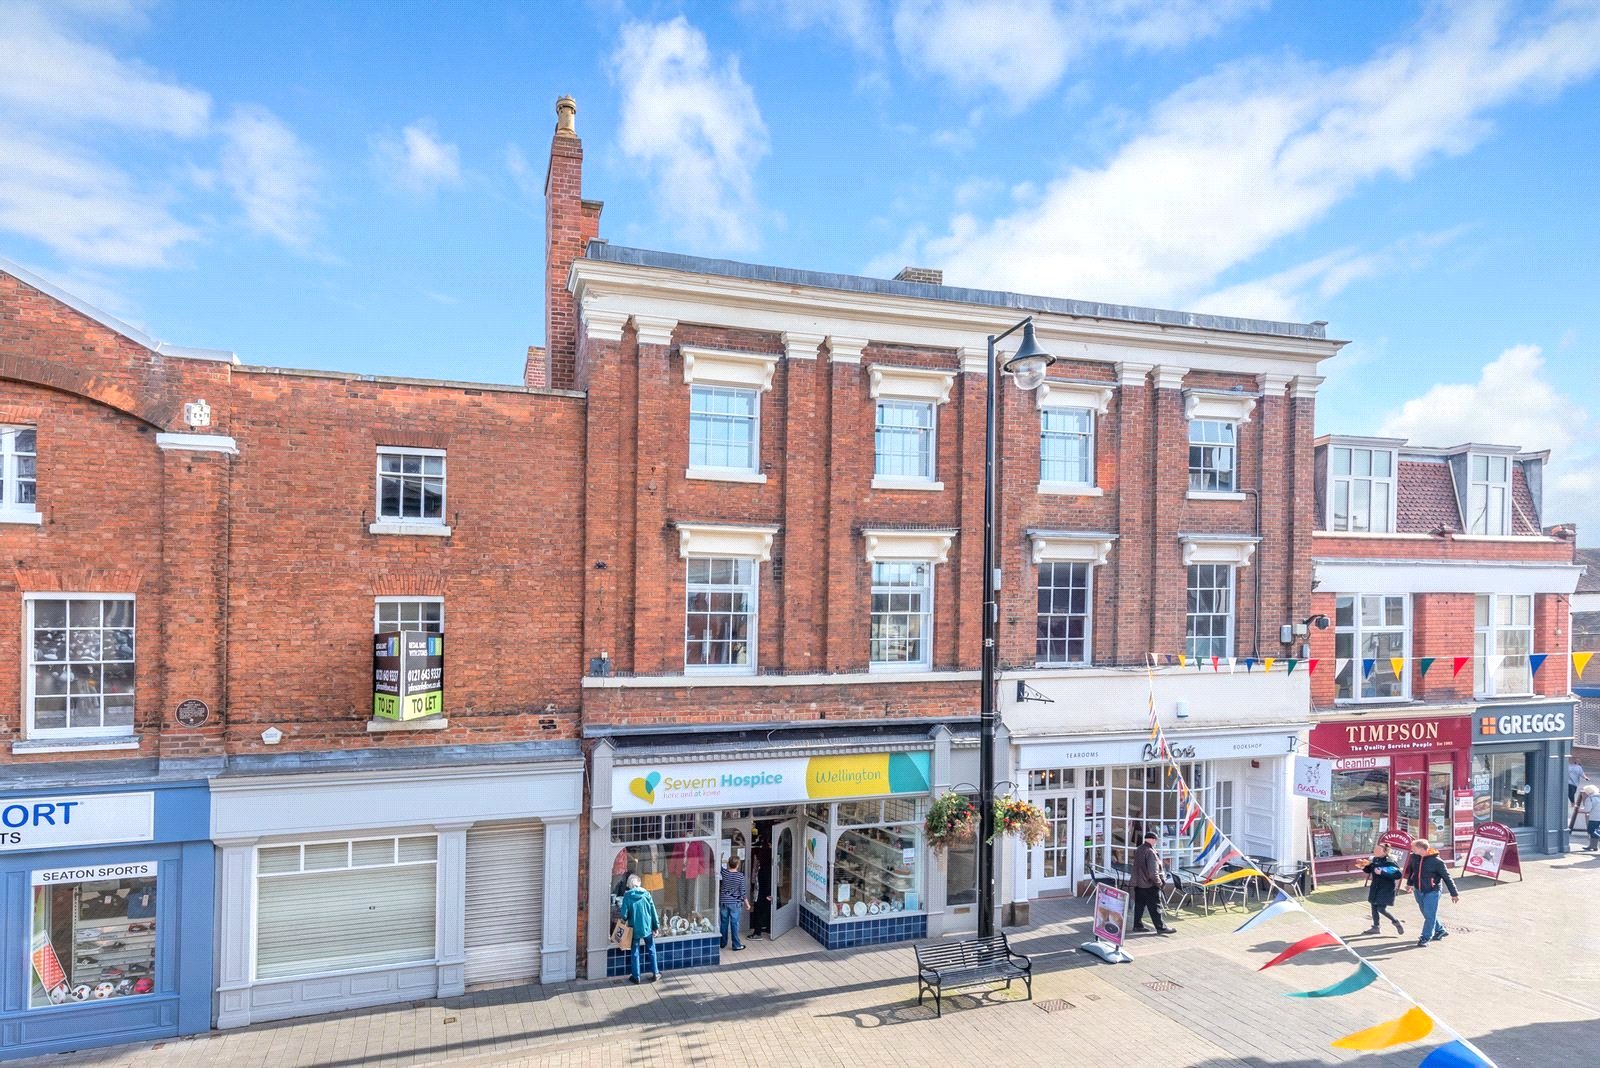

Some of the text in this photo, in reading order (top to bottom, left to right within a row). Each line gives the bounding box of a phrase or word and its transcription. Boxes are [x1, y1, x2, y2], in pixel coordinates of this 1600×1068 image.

[407, 669, 420, 682] 0121
[421, 669, 430, 680] 643
[378, 697, 394, 714] TO LET
[412, 695, 437, 714] TO LET
[1498, 712, 1566, 735] GREGGS
[1345, 722, 1439, 743] TIMPSON
[1232, 743, 1263, 751] BOOKSHOP
[1364, 744, 1386, 752] Quality
[1387, 742, 1410, 750] Service
[1412, 741, 1433, 749] People
[1066, 751, 1099, 759] TEAROOMS
[1335, 757, 1377, 769] Cleaning
[663, 768, 881, 791] Severn Hospice Wellington
[1480, 825, 1505, 835] TIMPSON
[0, 832, 21, 844] TS
[1385, 833, 1410, 845] TIMPSON
[42, 864, 148, 882] SEATON SPORTS
